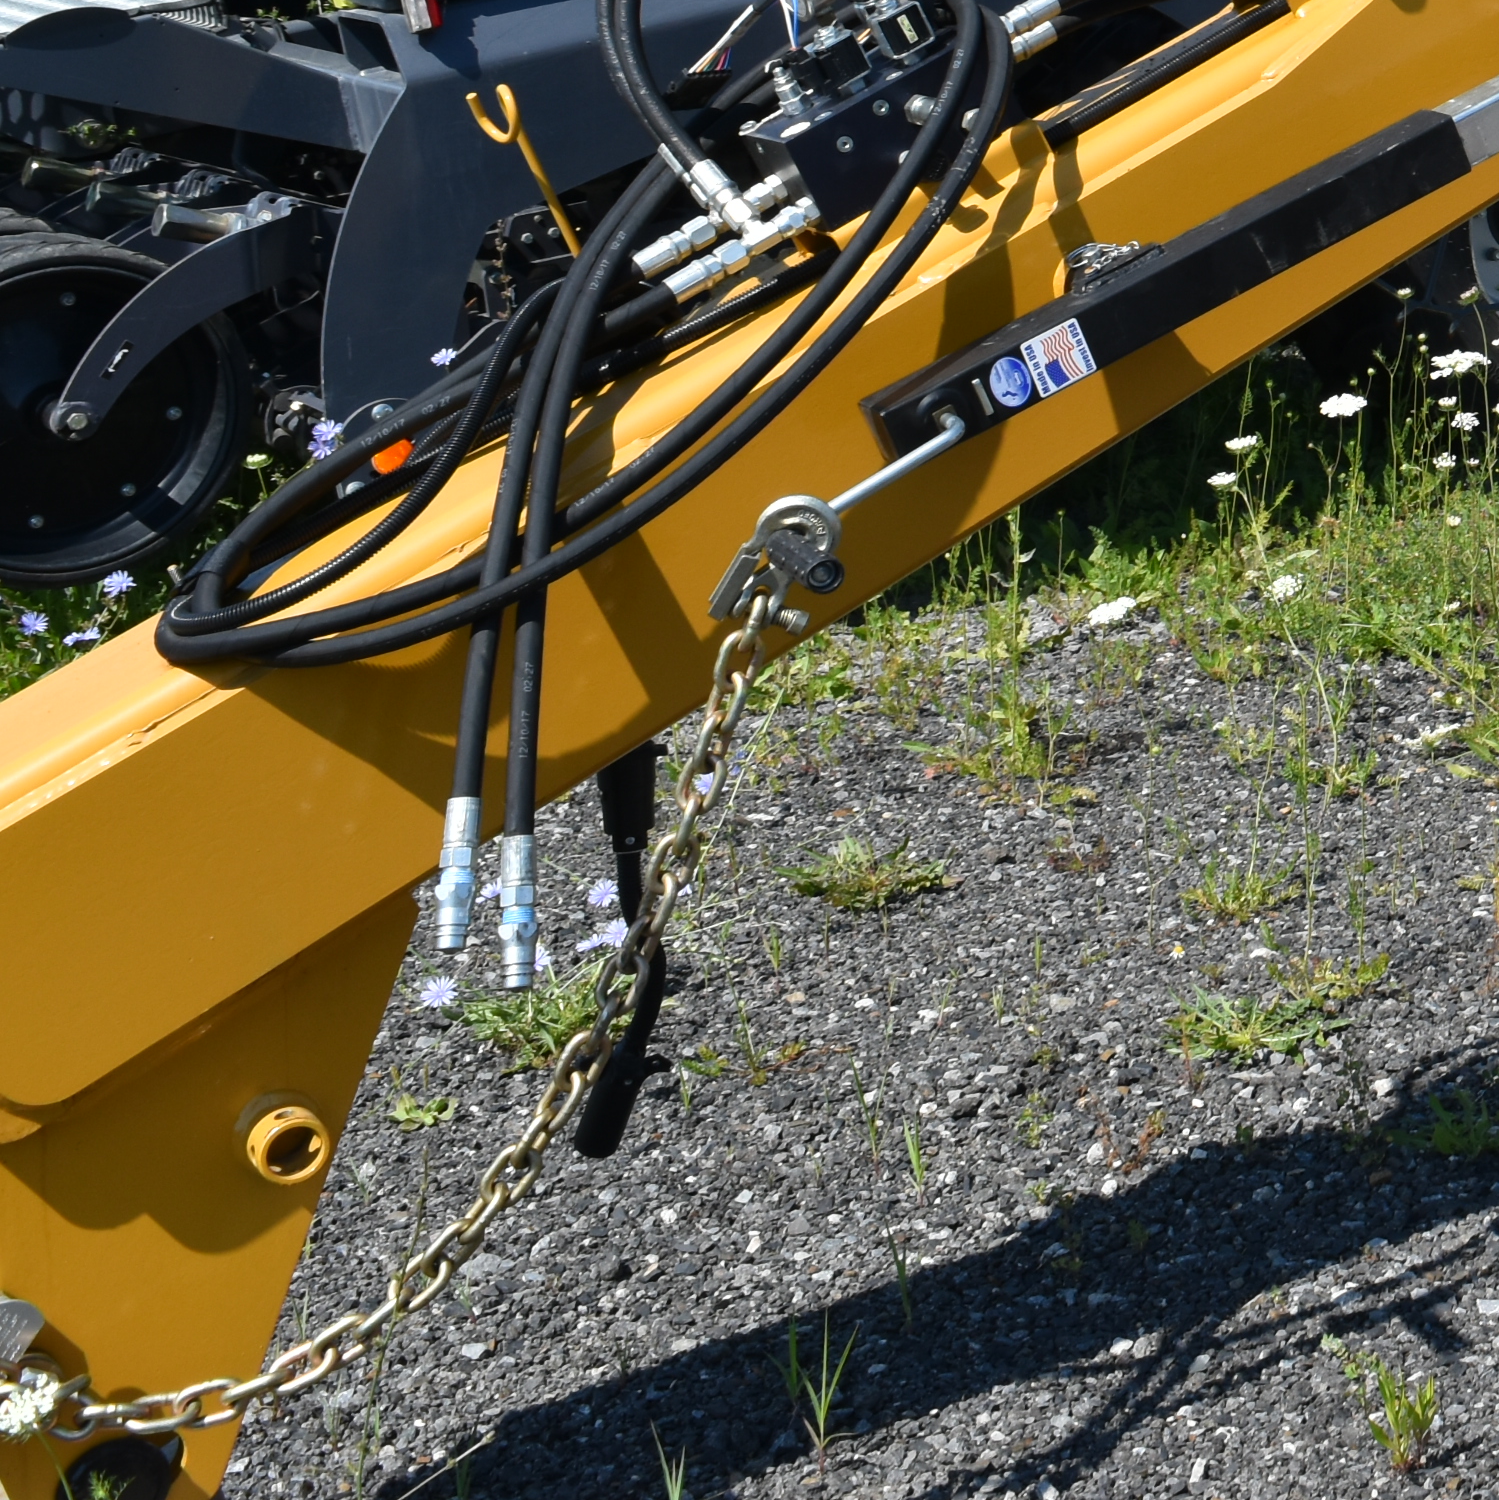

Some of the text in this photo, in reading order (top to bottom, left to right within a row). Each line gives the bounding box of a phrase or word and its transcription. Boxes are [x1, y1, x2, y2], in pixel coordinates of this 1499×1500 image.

[1067, 321, 1080, 339] USA
[1024, 343, 1037, 363] USA
[1078, 347, 1094, 373] Invest
[1036, 370, 1052, 395] Made
[360, 418, 406, 449] 12/10/17
[518, 710, 531, 759] 12/10/17
